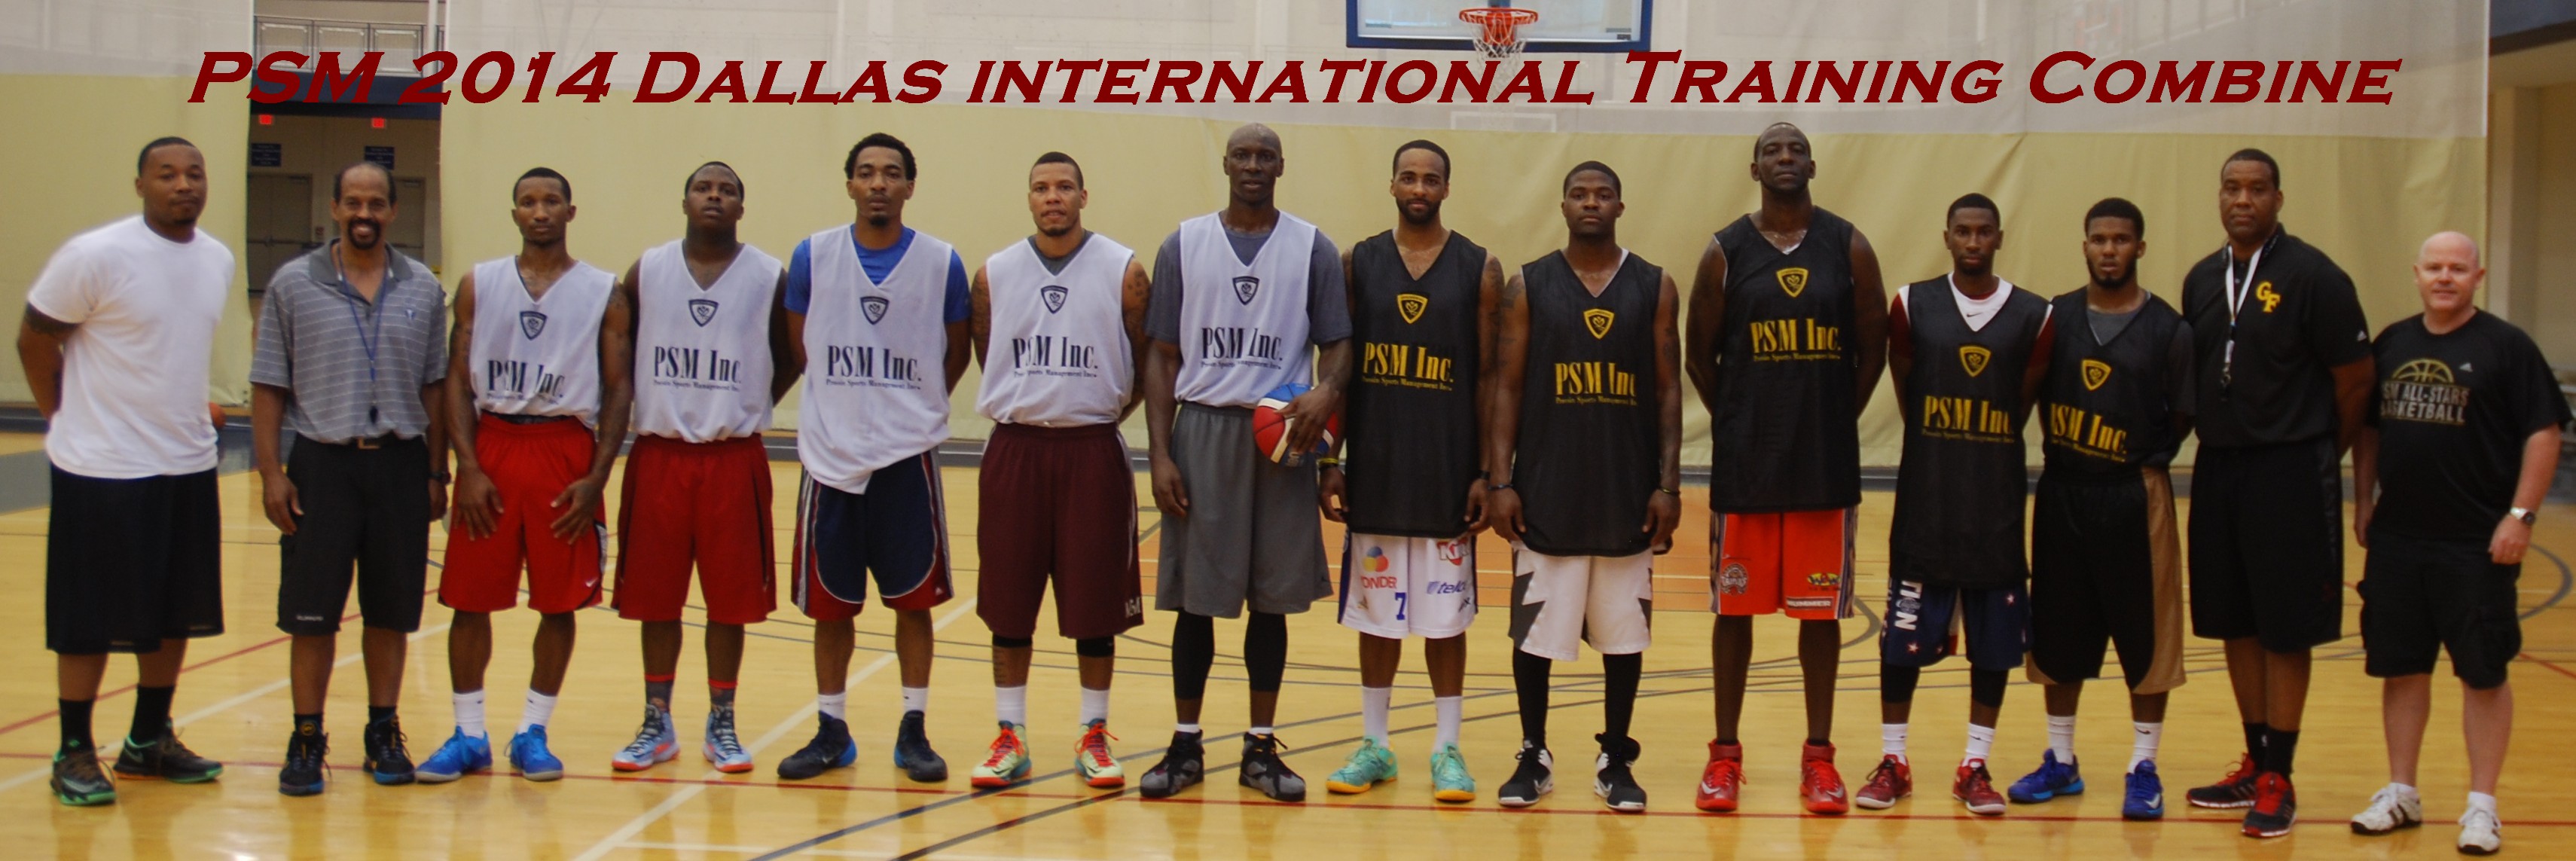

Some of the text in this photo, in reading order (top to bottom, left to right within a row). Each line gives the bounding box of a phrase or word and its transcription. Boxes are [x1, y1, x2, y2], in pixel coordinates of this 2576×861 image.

[2256, 281, 2281, 313] GF
[1201, 327, 1283, 361] PSM Inc.
[1750, 318, 1842, 353] PSM Inc.
[654, 346, 742, 384] PSM Inc.
[827, 345, 922, 382] PSM Inc.
[1061, 337, 1098, 369] Inc.
[1363, 342, 1454, 383] PSM Inc.
[1554, 362, 1604, 395] PSM
[2403, 384, 2470, 407] ALL-STARS
[1924, 395, 1973, 431] PSM
[2088, 414, 2127, 455] Inc.
[1395, 592, 1406, 621] 7
